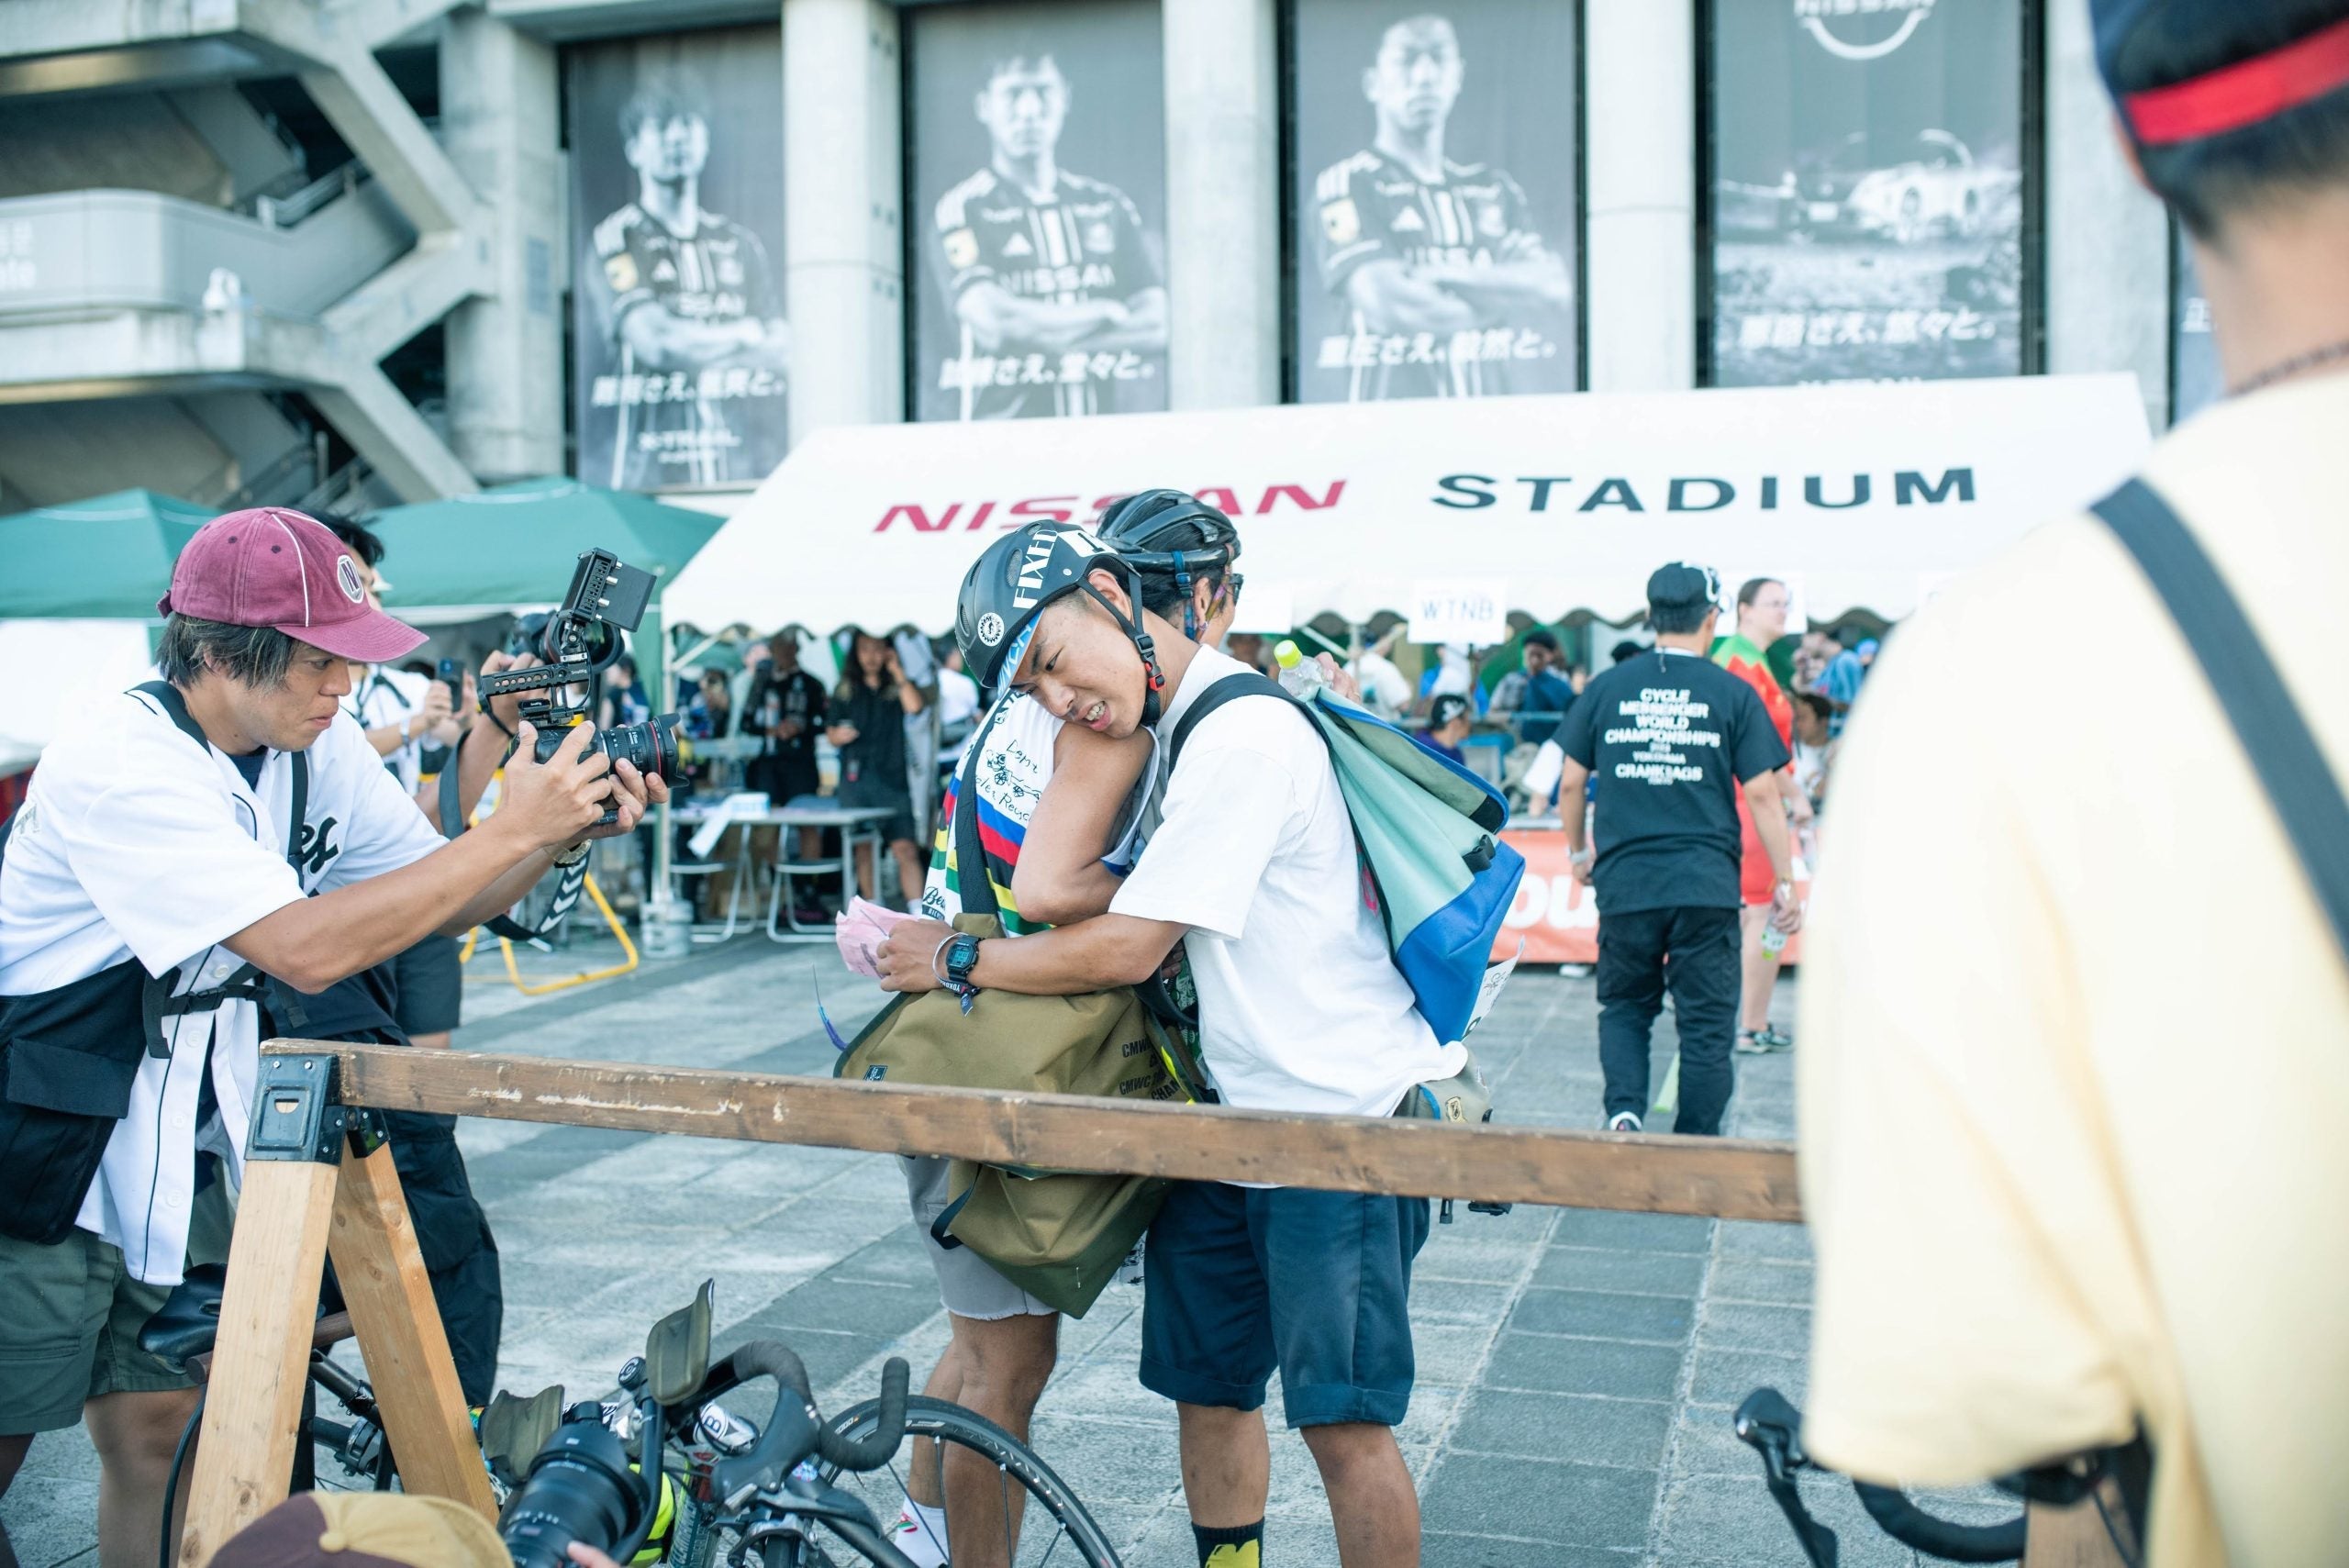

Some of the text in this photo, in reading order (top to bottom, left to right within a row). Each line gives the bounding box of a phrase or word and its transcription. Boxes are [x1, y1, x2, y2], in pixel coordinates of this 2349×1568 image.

[873, 467, 1976, 533] NISAN STADIUM
[1012, 529, 1058, 610] FIXED
[1640, 688, 1691, 703] CYCLE
[1635, 716, 1689, 731] WORLD
